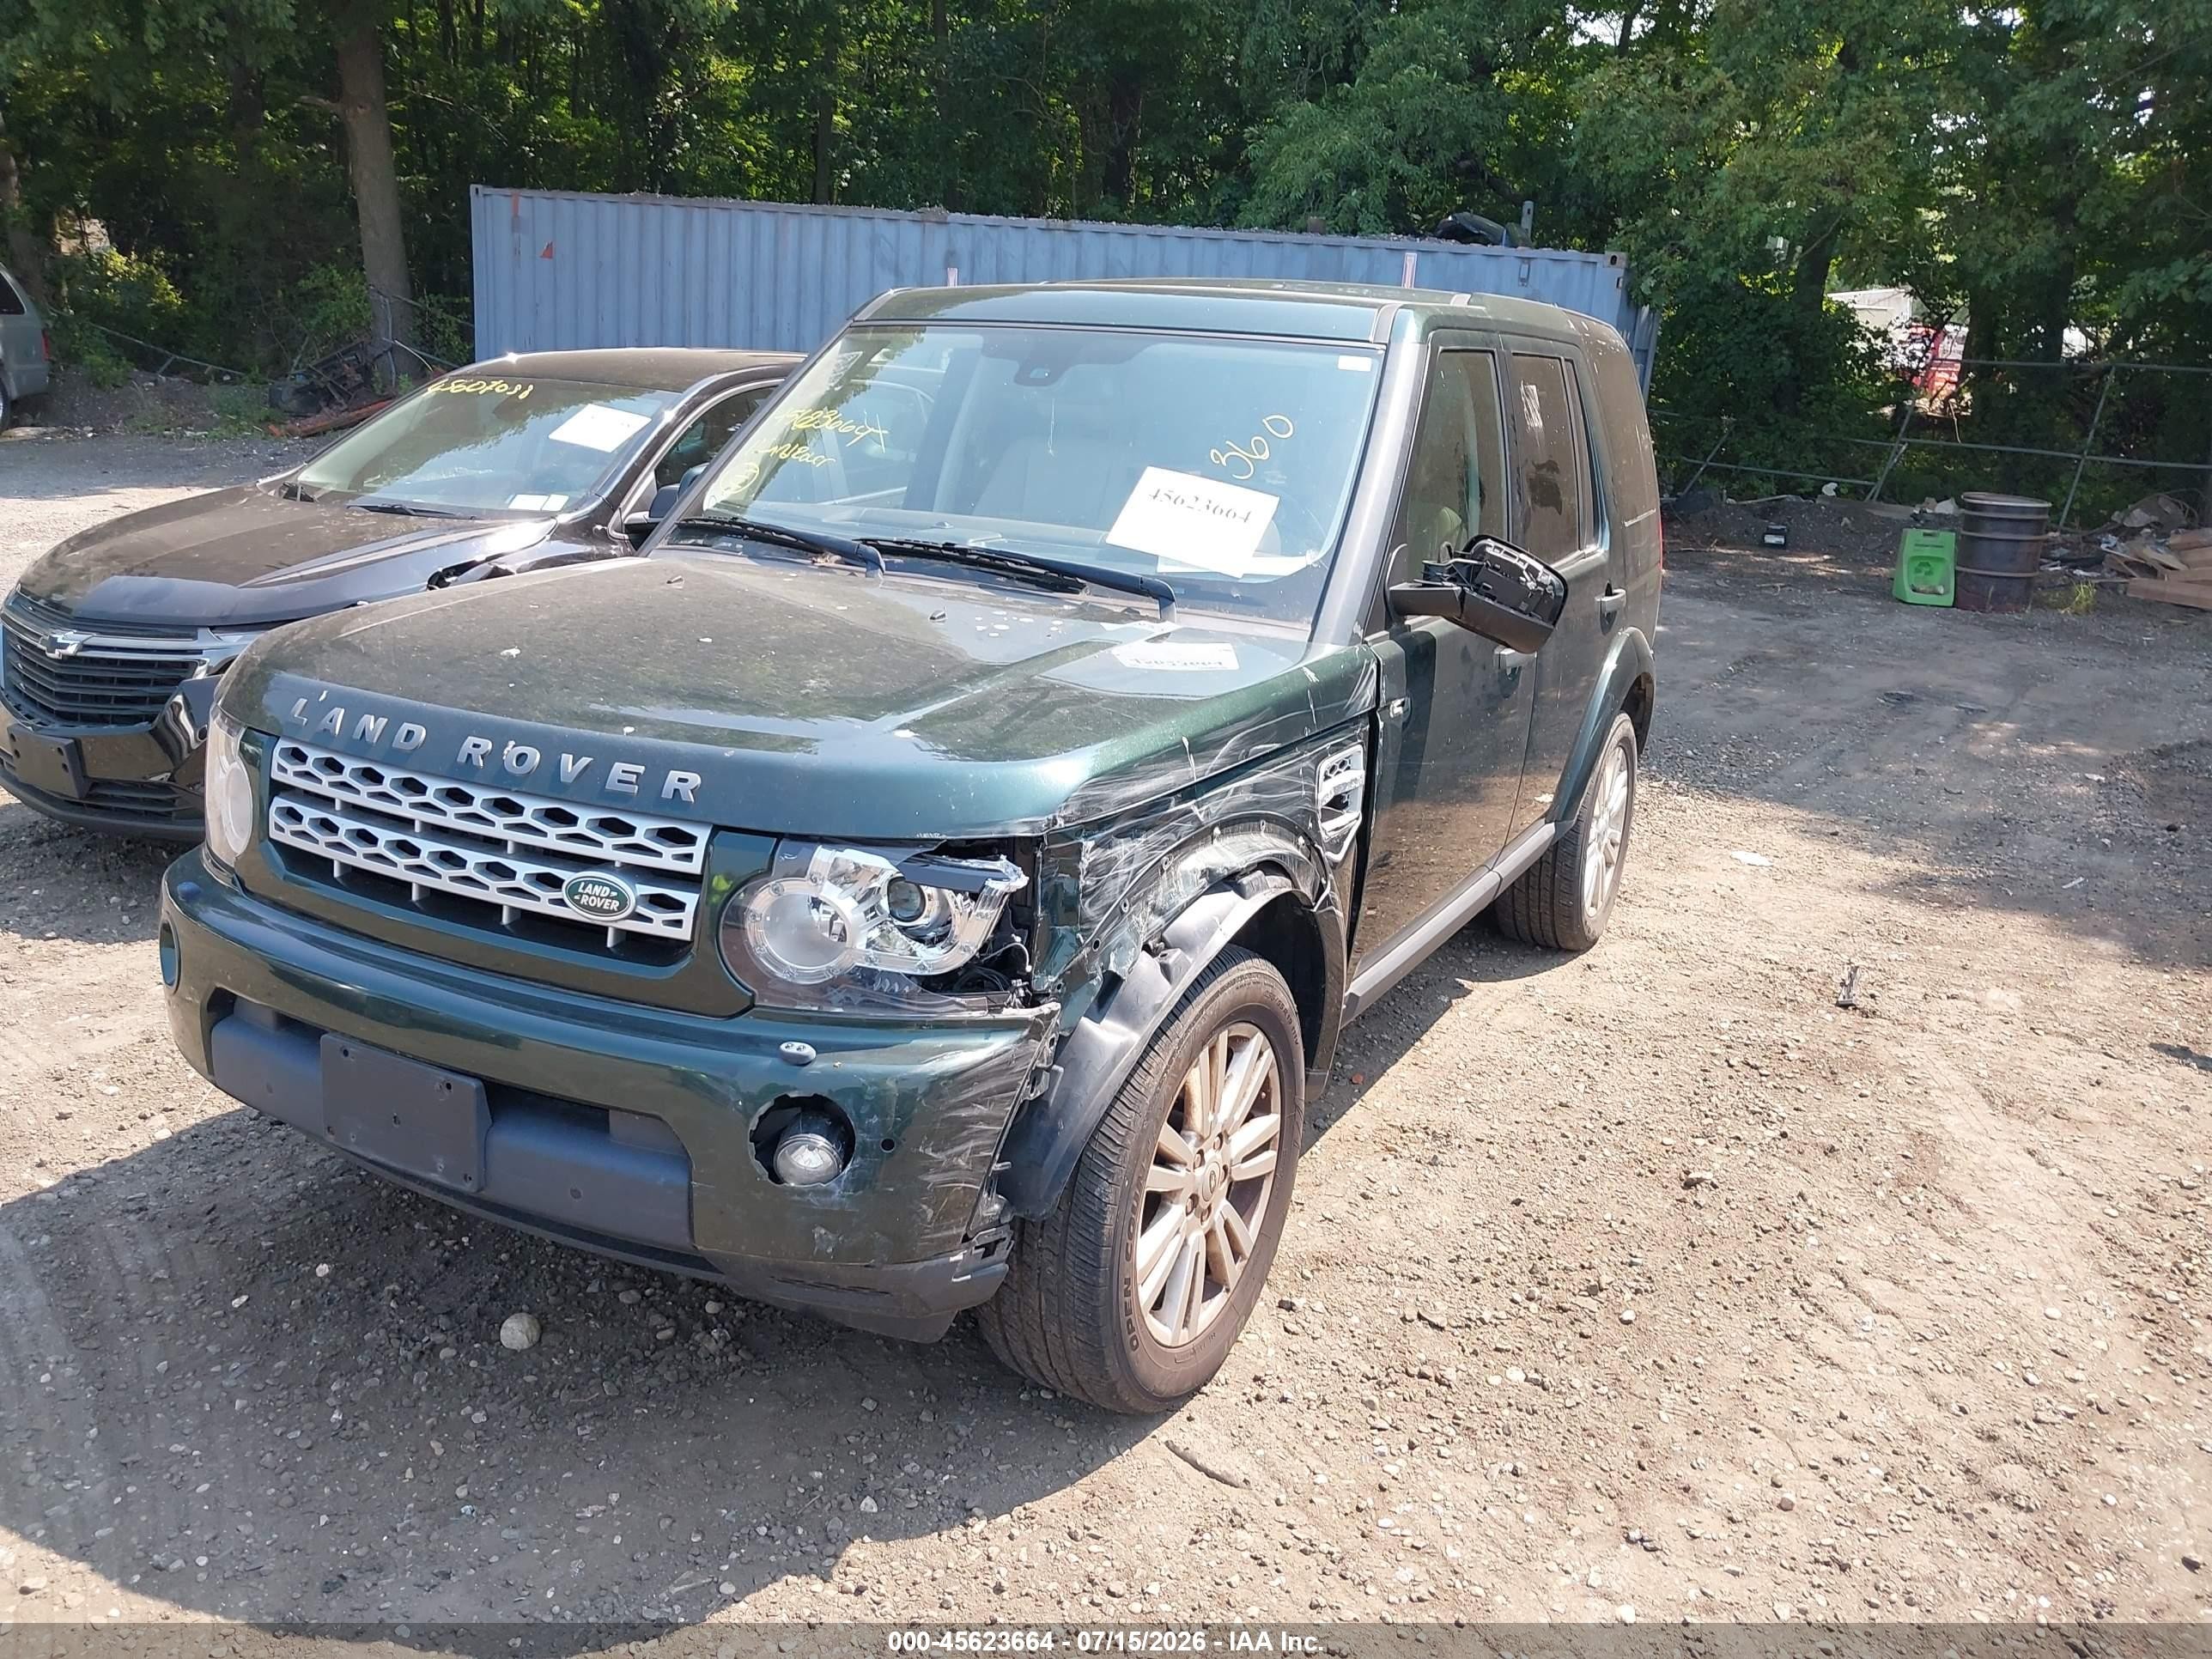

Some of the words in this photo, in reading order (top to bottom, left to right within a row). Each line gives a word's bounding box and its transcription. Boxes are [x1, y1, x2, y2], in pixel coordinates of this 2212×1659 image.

[1210, 414, 1294, 480] 360
[289, 697, 427, 750] LAND
[456, 736, 702, 804] ROVER
[578, 881, 611, 897] LAND
[580, 894, 620, 912] ROVER
[1123, 1277, 1139, 1352] OPEN
